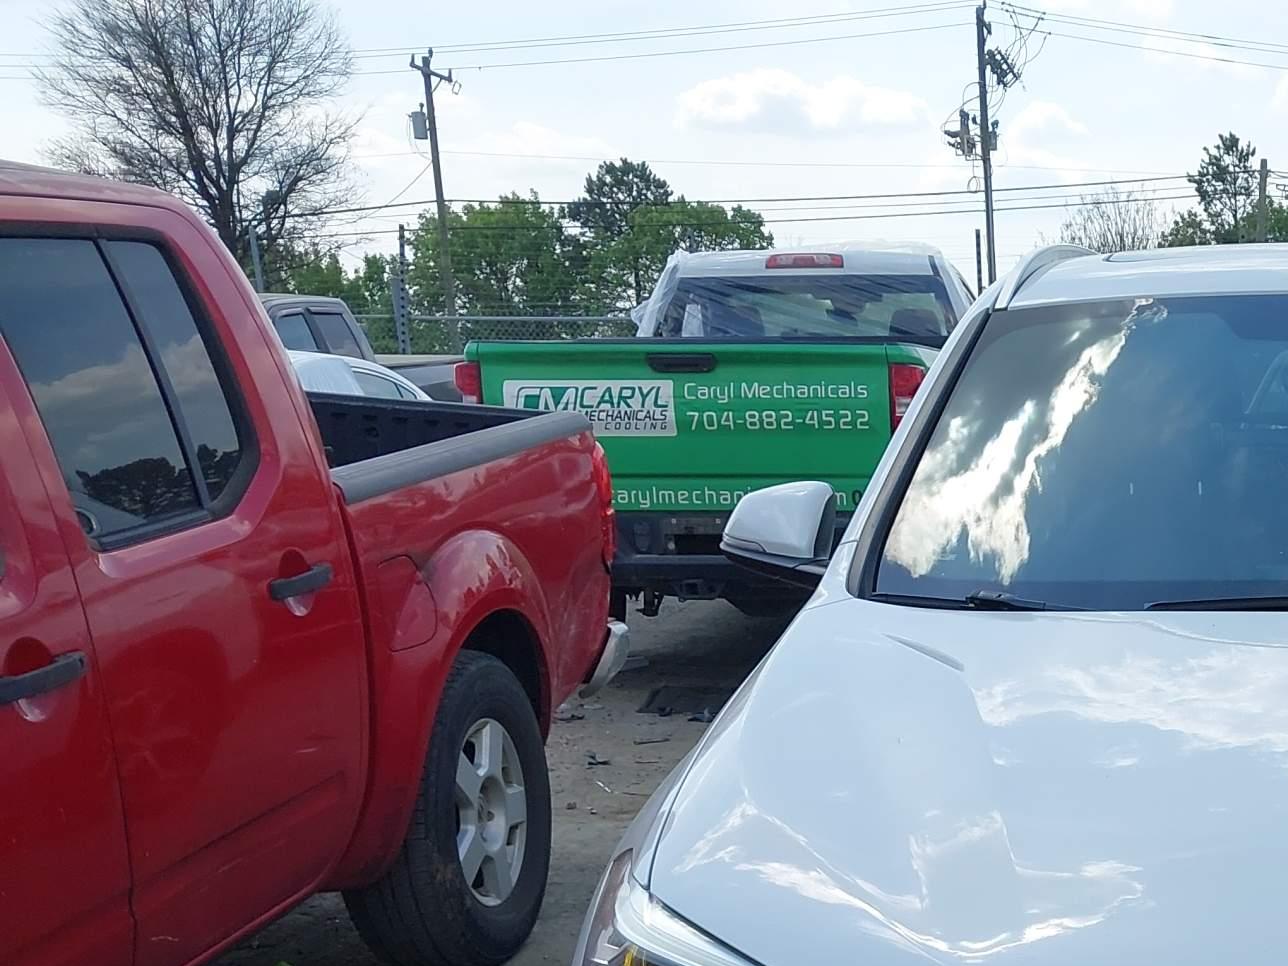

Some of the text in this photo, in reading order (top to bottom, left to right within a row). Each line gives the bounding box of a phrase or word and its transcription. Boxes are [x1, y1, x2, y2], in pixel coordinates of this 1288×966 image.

[579, 386, 669, 409] CARYL
[684, 381, 868, 403] Caryl Mechanicals
[604, 421, 668, 431] COOLING
[685, 410, 870, 430] 704-882-4522
